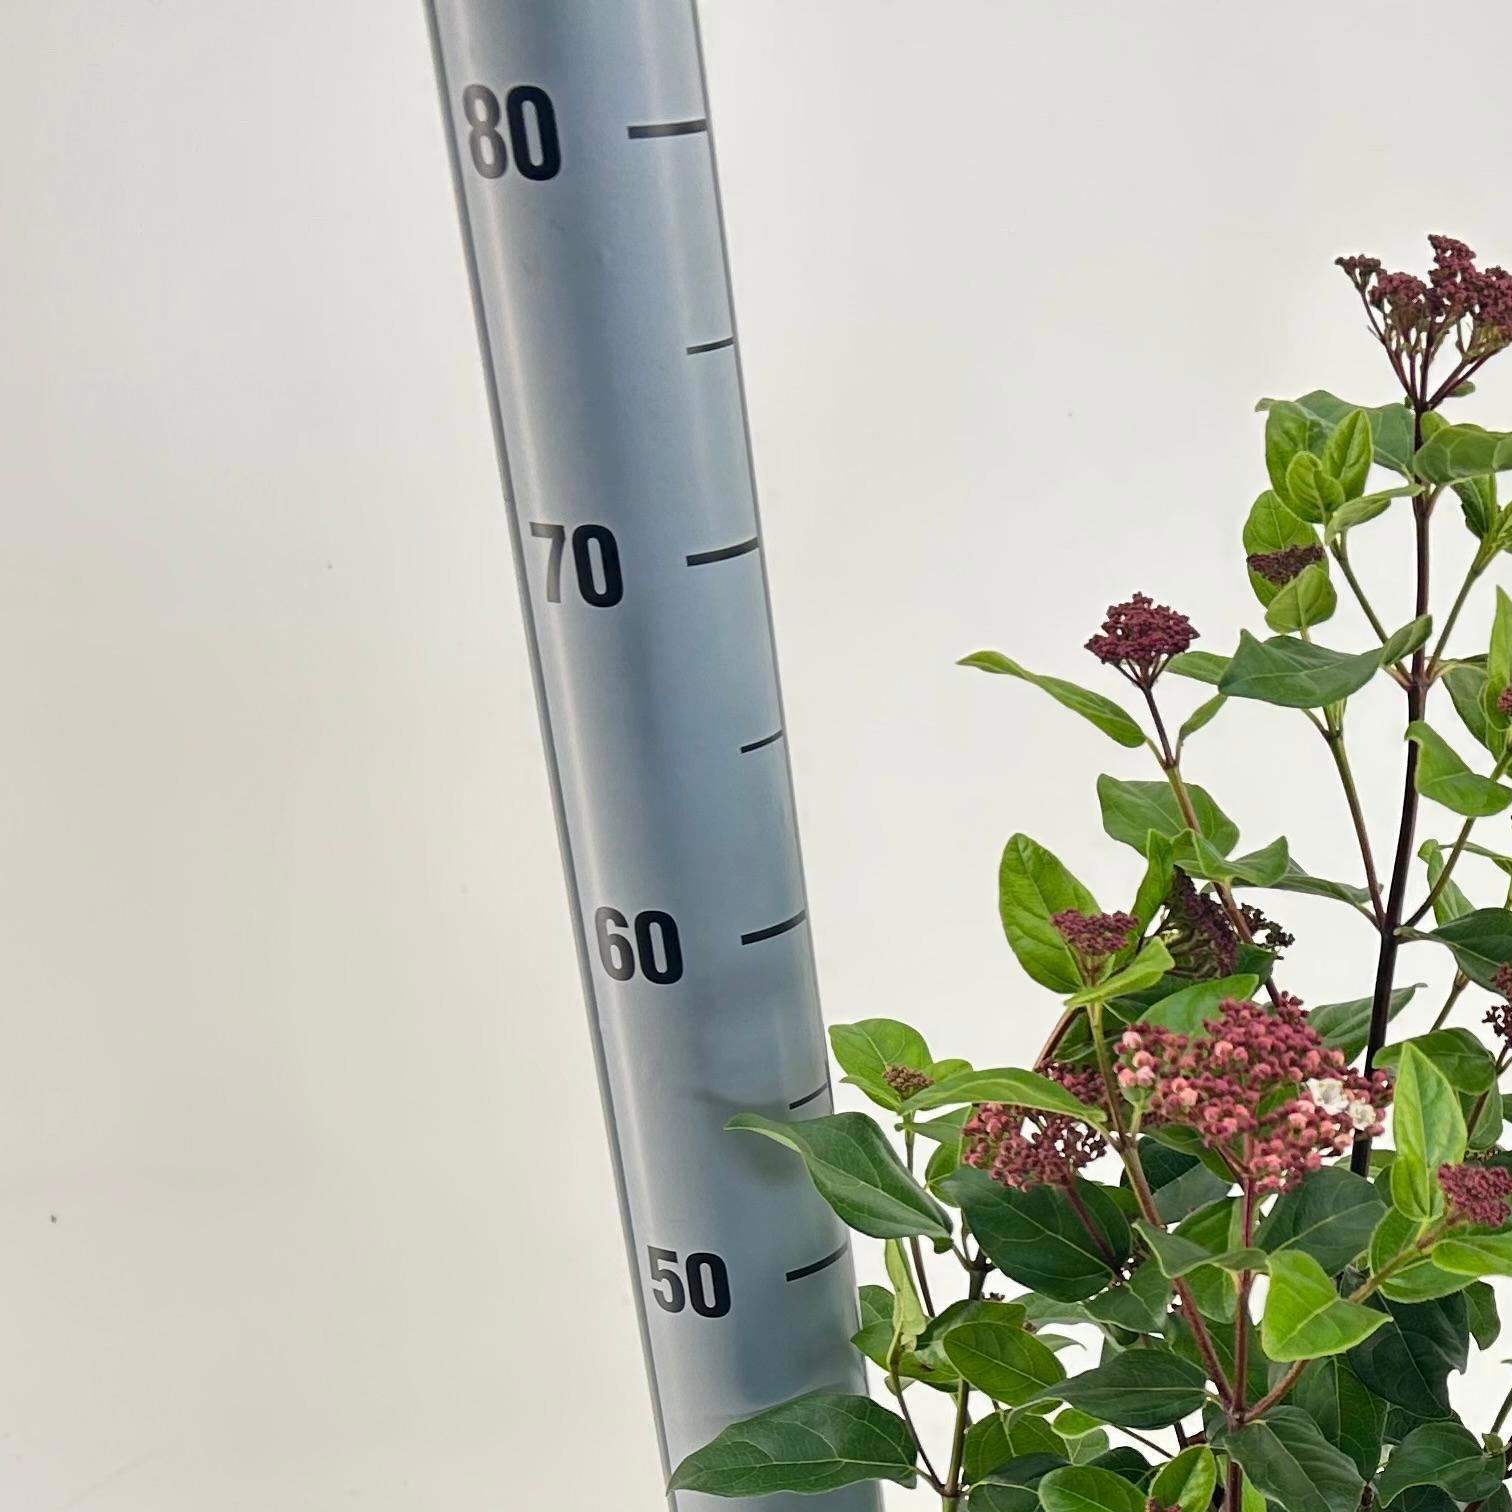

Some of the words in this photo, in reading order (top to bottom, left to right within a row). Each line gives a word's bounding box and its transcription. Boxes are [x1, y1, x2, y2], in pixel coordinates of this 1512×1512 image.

[461, 83, 561, 181] 80
[529, 521, 624, 608] 70
[594, 906, 685, 986] 60
[647, 1245, 731, 1319] 50
